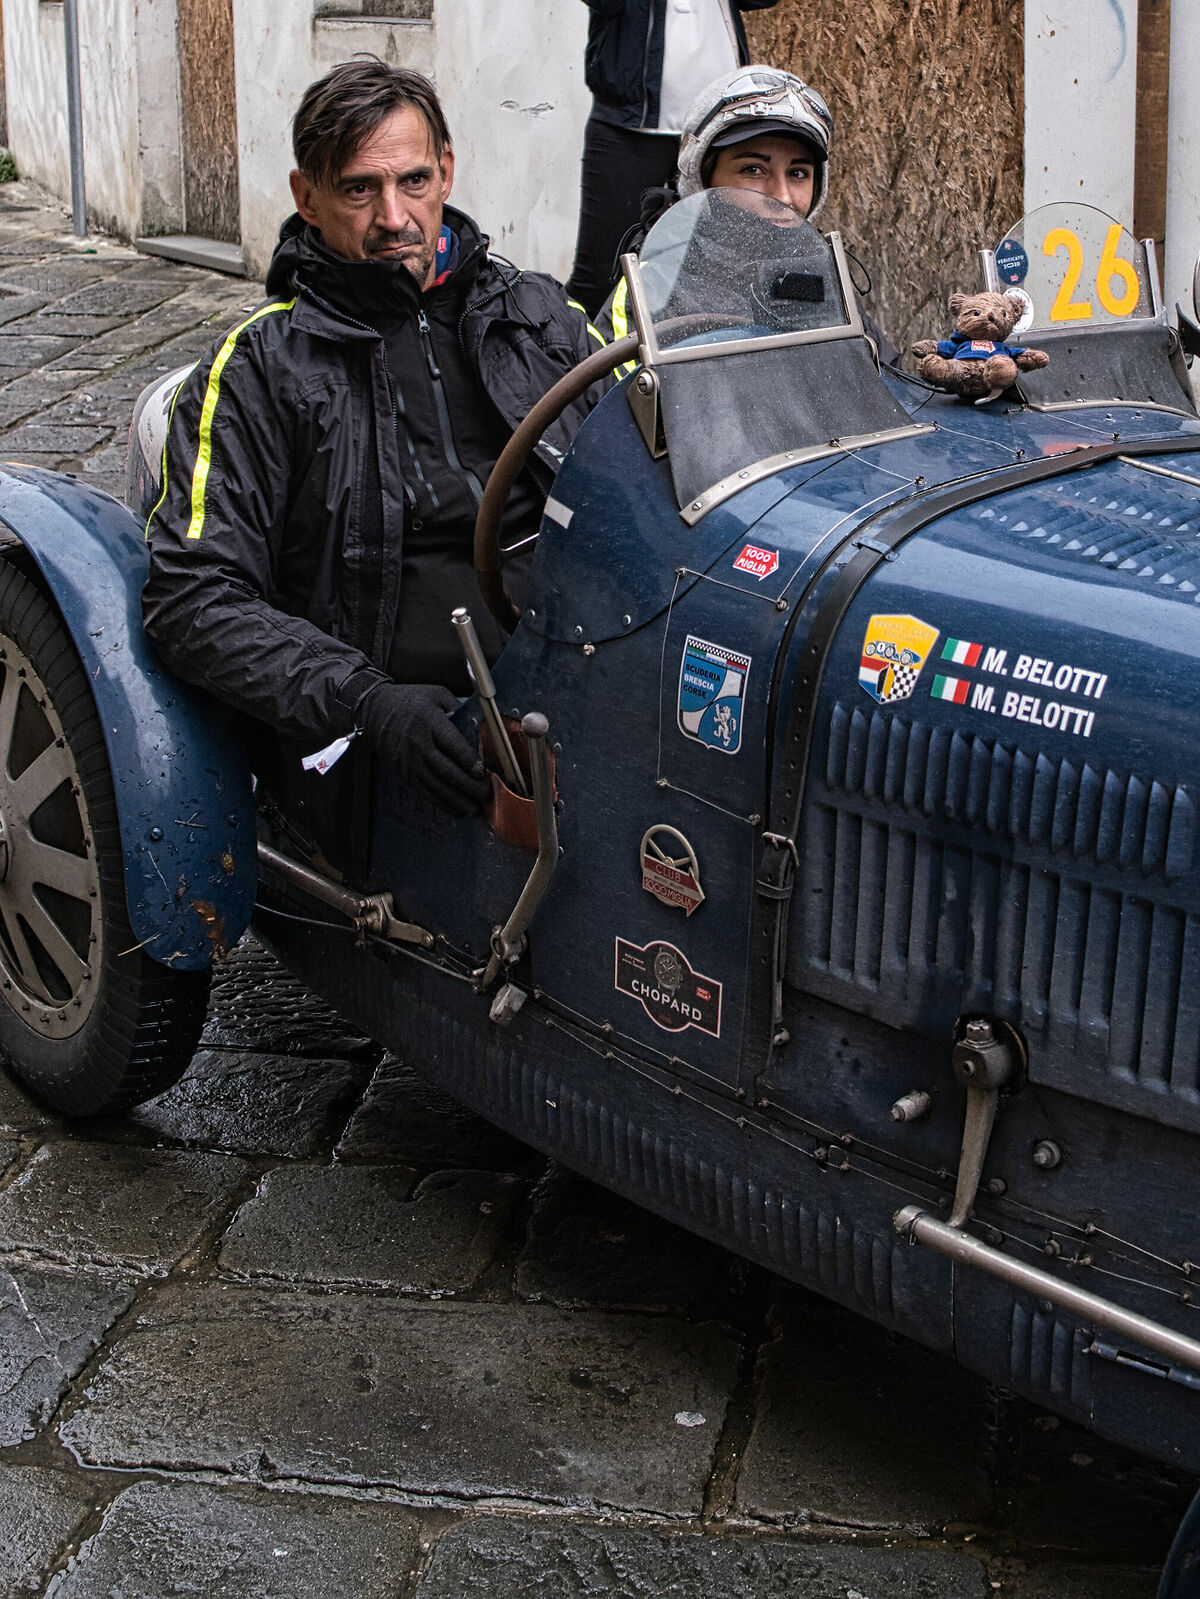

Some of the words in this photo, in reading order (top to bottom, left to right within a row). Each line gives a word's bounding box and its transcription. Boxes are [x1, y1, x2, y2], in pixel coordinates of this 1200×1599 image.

[1042, 224, 1140, 321] 26
[745, 548, 771, 563] 1000
[736, 557, 767, 574] MIGLIA
[685, 663, 721, 682] SCUDERIA
[981, 647, 1008, 676] M.
[1012, 654, 1108, 699] BELOTTI
[683, 684, 707, 699] CORSE
[684, 673, 715, 692] BRESCIA
[970, 683, 997, 714] M.
[1001, 691, 1096, 738] BELOTTI
[655, 863, 681, 882] CLUB
[631, 980, 702, 1021] CHOPARD
